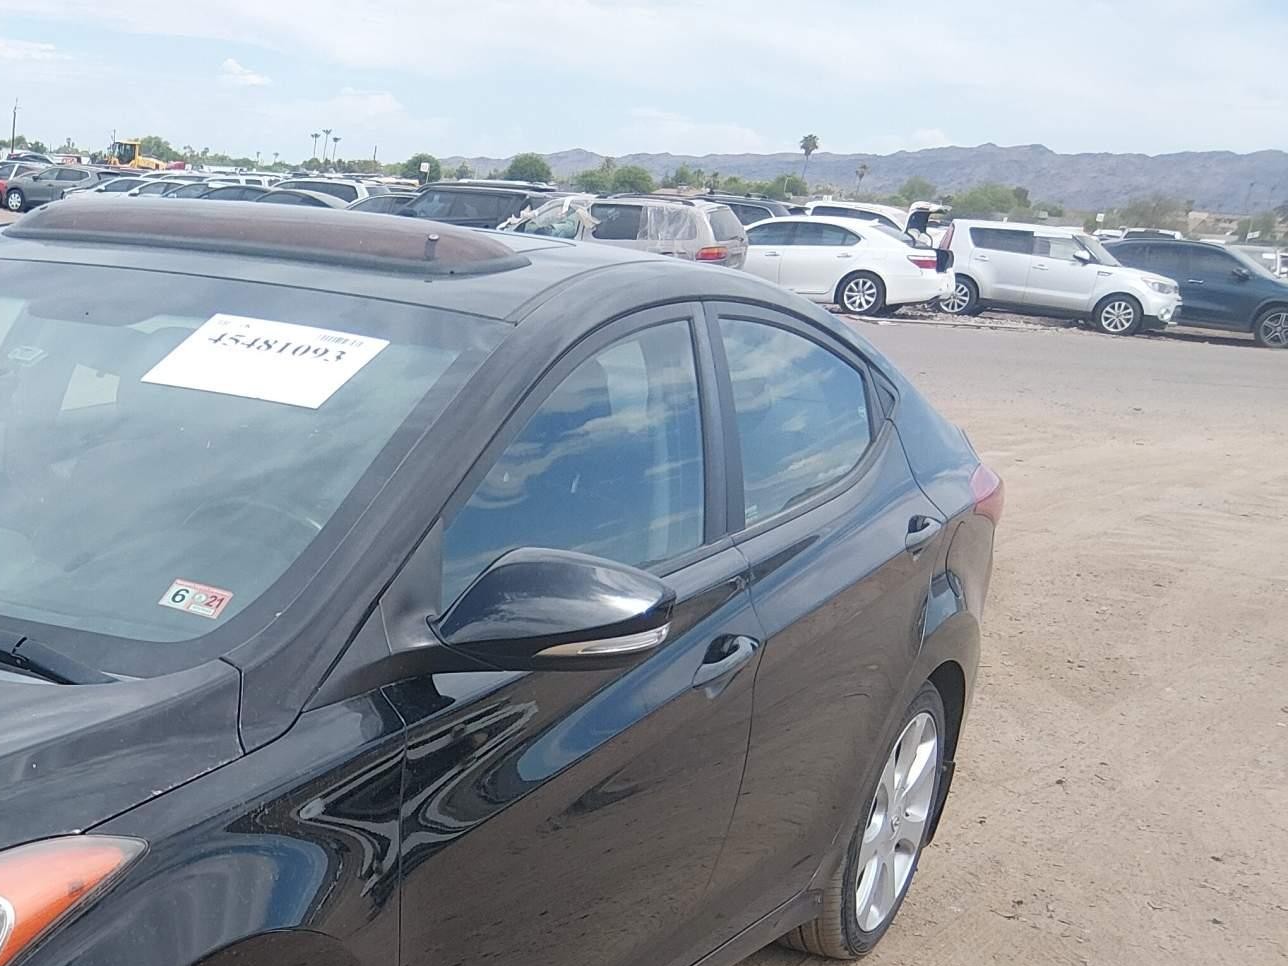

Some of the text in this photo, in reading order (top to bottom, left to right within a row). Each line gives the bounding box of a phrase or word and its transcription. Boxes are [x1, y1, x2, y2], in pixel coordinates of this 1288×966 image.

[207, 332, 347, 362] 45481093
[171, 588, 189, 603] 6
[205, 596, 224, 608] 21
